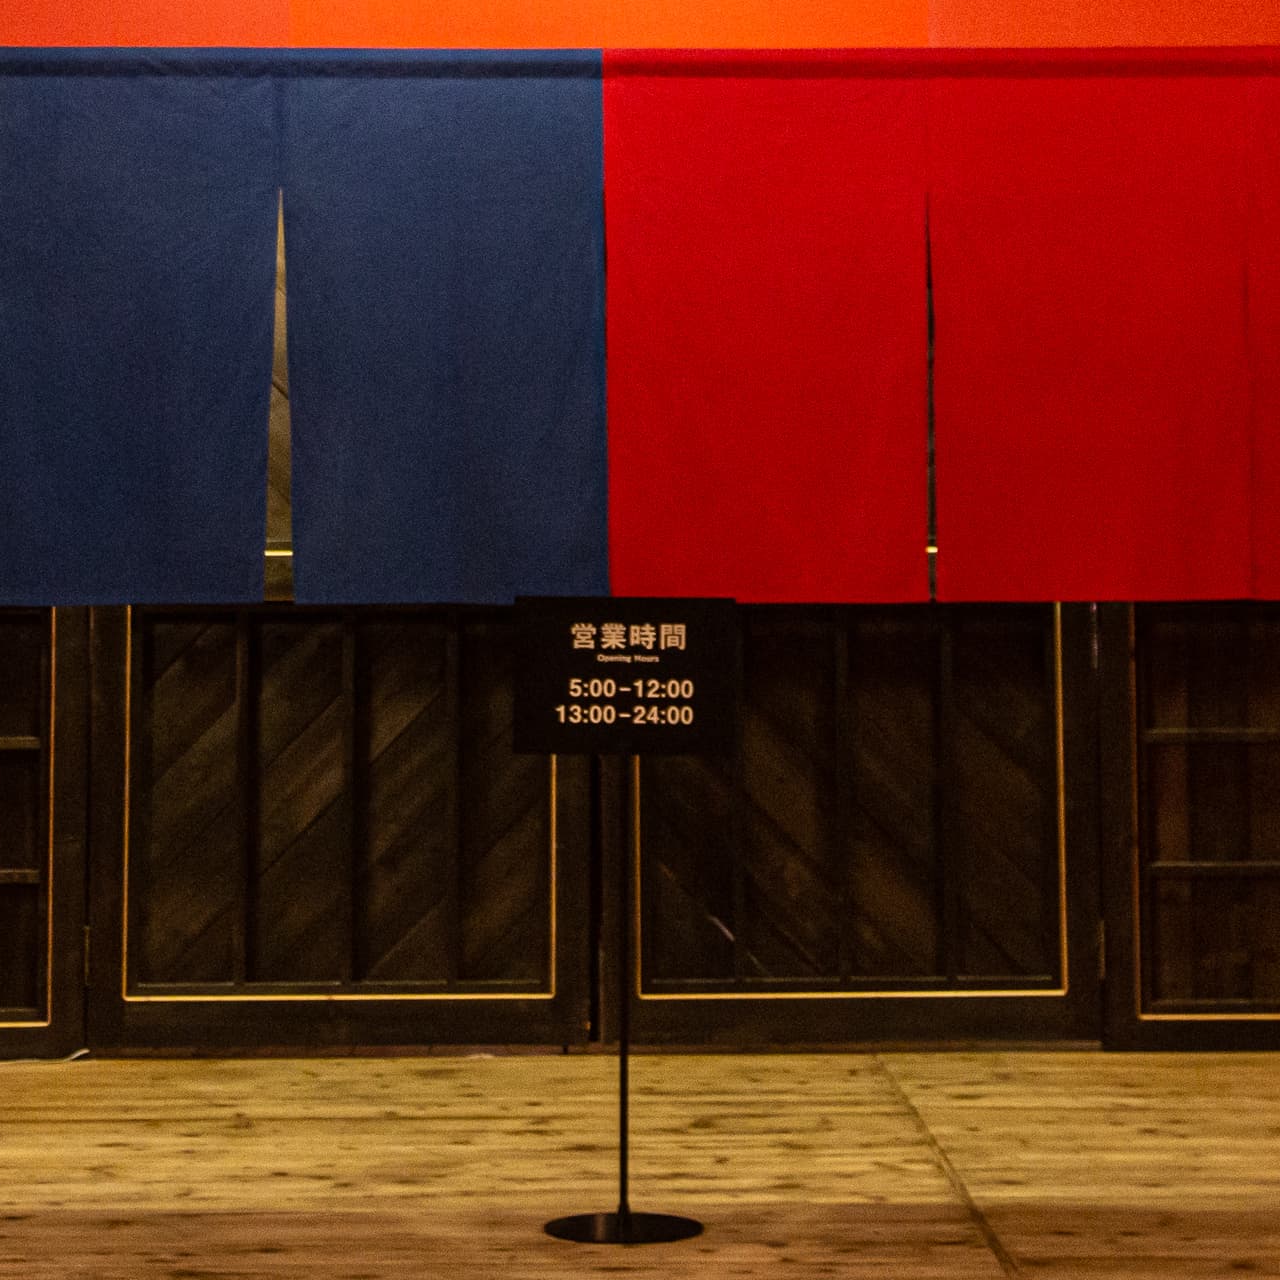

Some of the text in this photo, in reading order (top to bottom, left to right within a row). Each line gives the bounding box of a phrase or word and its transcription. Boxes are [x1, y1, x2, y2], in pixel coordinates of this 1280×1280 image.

[571, 622, 687, 651] 営業時間
[596, 653, 660, 664] Opening Hours
